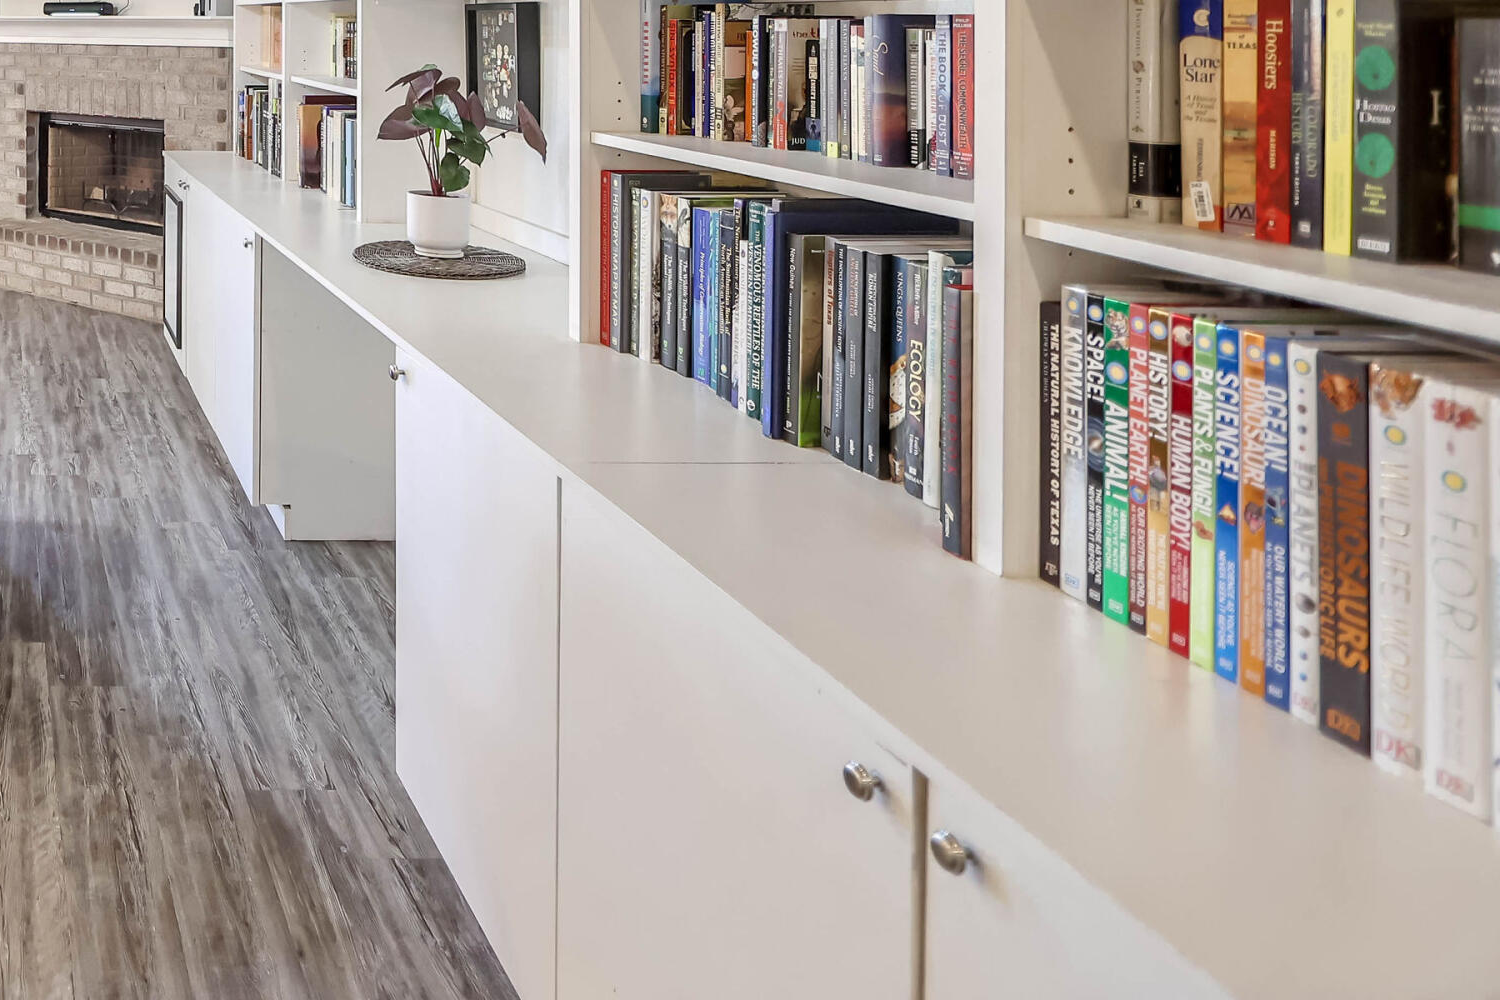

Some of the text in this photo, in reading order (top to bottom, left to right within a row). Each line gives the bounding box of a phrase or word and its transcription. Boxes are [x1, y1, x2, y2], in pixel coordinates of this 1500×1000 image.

[938, 31, 946, 53] THE
[938, 56, 946, 91] BOOK
[959, 49, 967, 79] SECRET
[1183, 53, 1220, 69] Lone
[1185, 68, 1216, 83] Star
[1264, 18, 1284, 90] Hoosiers
[938, 114, 946, 146] DUST
[959, 80, 967, 149] COMMONWEALTH
[1292, 92, 1304, 145] HISTORY
[1305, 105, 1318, 178] COLORADO
[612, 281, 619, 299] BY
[827, 250, 835, 286] Raptors
[752, 244, 761, 390] VENOMOUS REPTILES OF THE
[827, 300, 835, 325] Texas
[895, 271, 903, 343] KINGS QUEENS
[909, 339, 923, 423] ECOLOGY
[1062, 325, 1083, 459] KNOWLEDGE
[1086, 332, 1105, 404] SPACE!
[1149, 351, 1168, 442] HISTORY!
[1193, 365, 1214, 438] PLANTS
[1050, 323, 1060, 546] THE NATURAL HISTORY OF TEXAS
[1104, 399, 1129, 503] ANIMAL!
[1129, 346, 1148, 485] PLANET EARTH!
[1170, 413, 1191, 490] HUMAN
[1193, 437, 1214, 453] &
[1215, 369, 1240, 481] SCIENCE!
[1242, 377, 1266, 490] DINOSAUR!
[1264, 384, 1288, 473] OCEAN!
[1137, 507, 1146, 528] OUR
[1170, 490, 1191, 551] BODY!
[1137, 573, 1146, 608] WORLD
[1336, 460, 1370, 674] DINOSAURS
[1274, 545, 1286, 674] OUR WATERY WORLD
